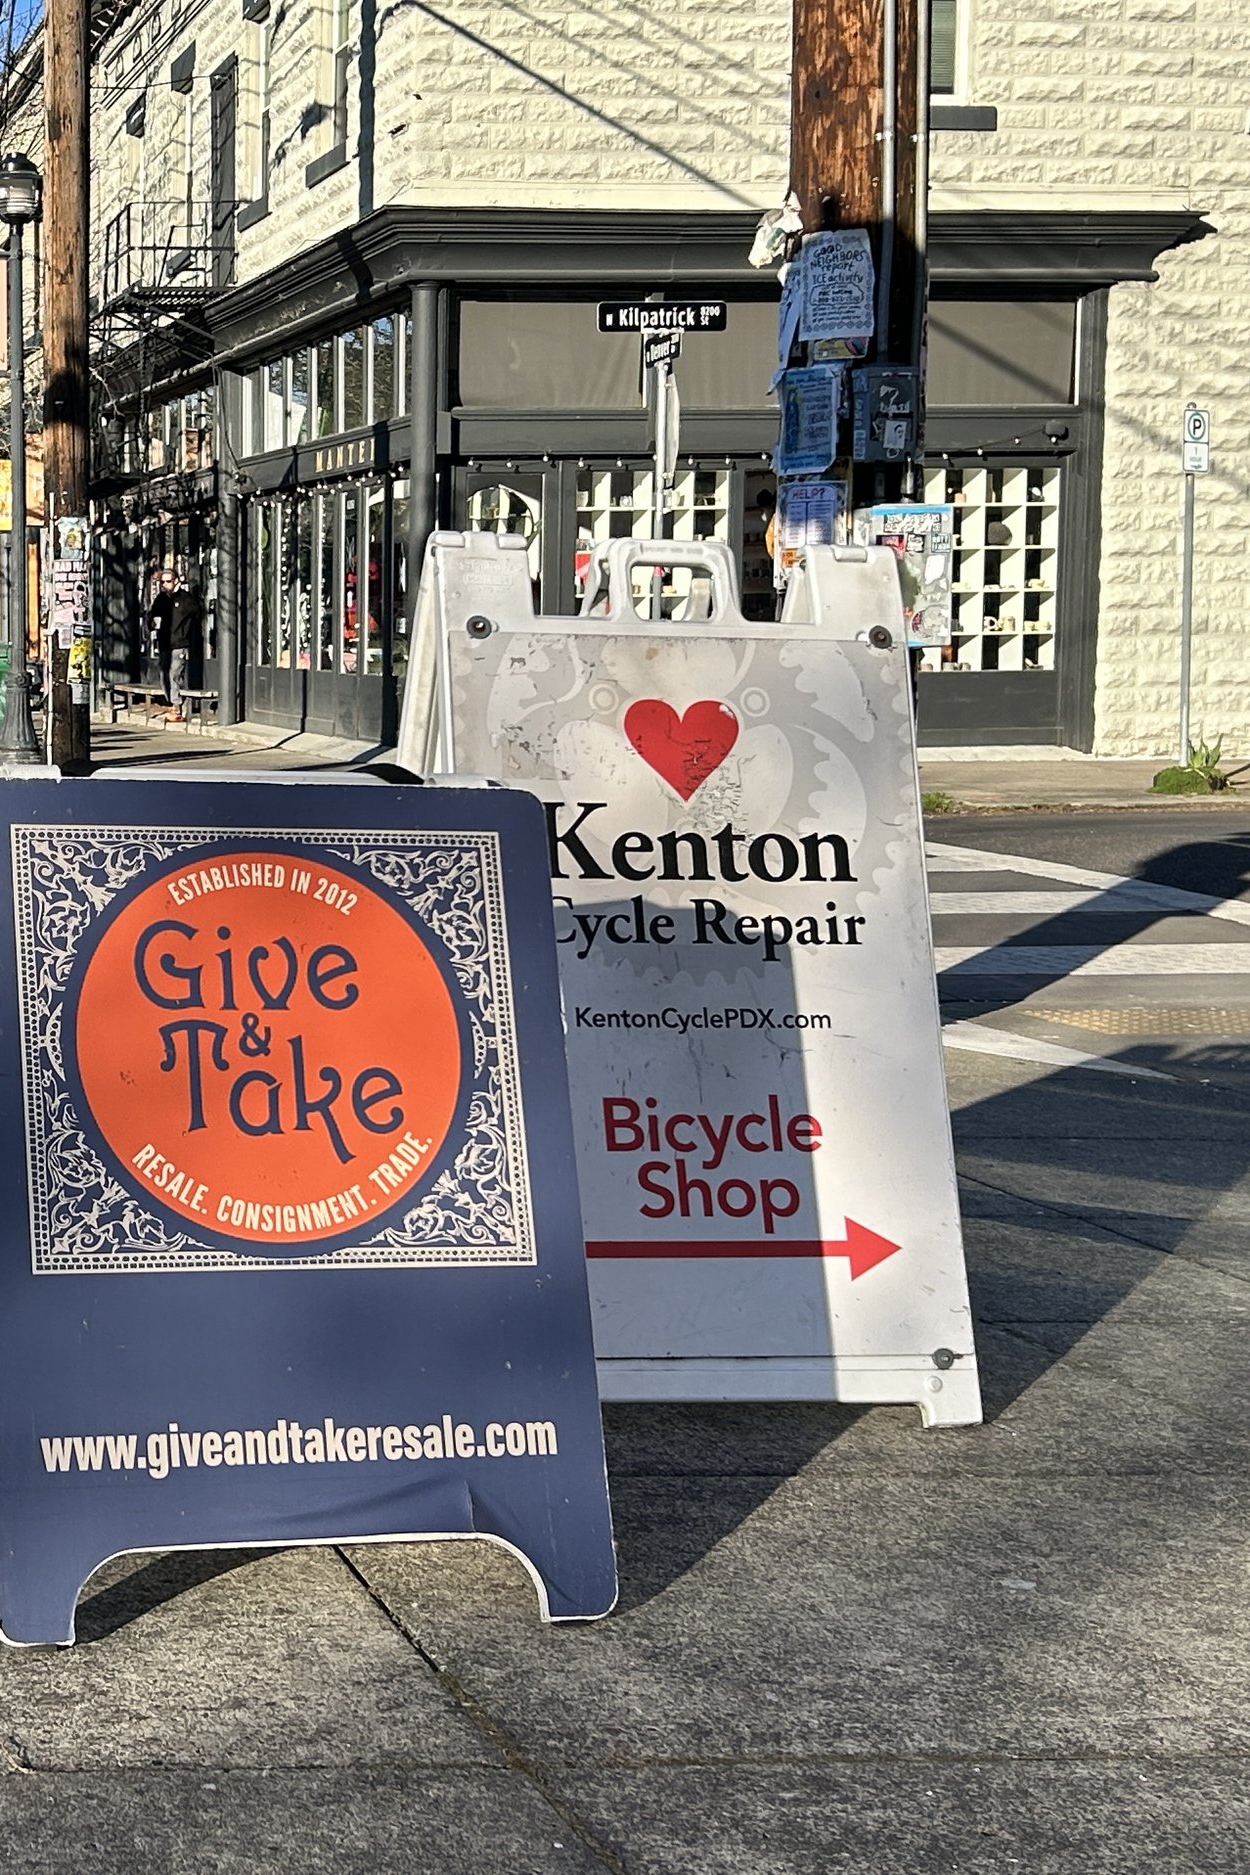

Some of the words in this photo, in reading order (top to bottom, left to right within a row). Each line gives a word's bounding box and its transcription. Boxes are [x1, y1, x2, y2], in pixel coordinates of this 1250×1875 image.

[810, 249, 865, 270] NEIGHBORS
[813, 243, 842, 258] GOOD
[821, 261, 854, 274] report
[813, 273, 828, 284] ICE
[828, 271, 864, 283] activity
[606, 313, 613, 326] N
[619, 307, 695, 327] Kilpatrick
[700, 315, 710, 326] St
[700, 306, 720, 316] 8200
[792, 487, 825, 500] HELP?
[542, 802, 858, 882] Kenton
[167, 863, 285, 906] ESTABLISHED
[290, 869, 310, 892] IN
[313, 877, 359, 916] 2012
[690, 898, 866, 962] Repair
[134, 919, 360, 1011] Give
[239, 1012, 271, 1057] &
[575, 1006, 832, 1035] KentonCyclePDX.com
[158, 1020, 404, 1164] Take
[602, 1094, 823, 1170] Bicycle
[132, 1142, 208, 1215] RESALE.
[216, 1184, 377, 1233] CONSIGNMENT.
[368, 1131, 433, 1195] TRADE.
[638, 1158, 800, 1234] Shop
[40, 1414, 558, 1480] www.giveandtakeresale.com
